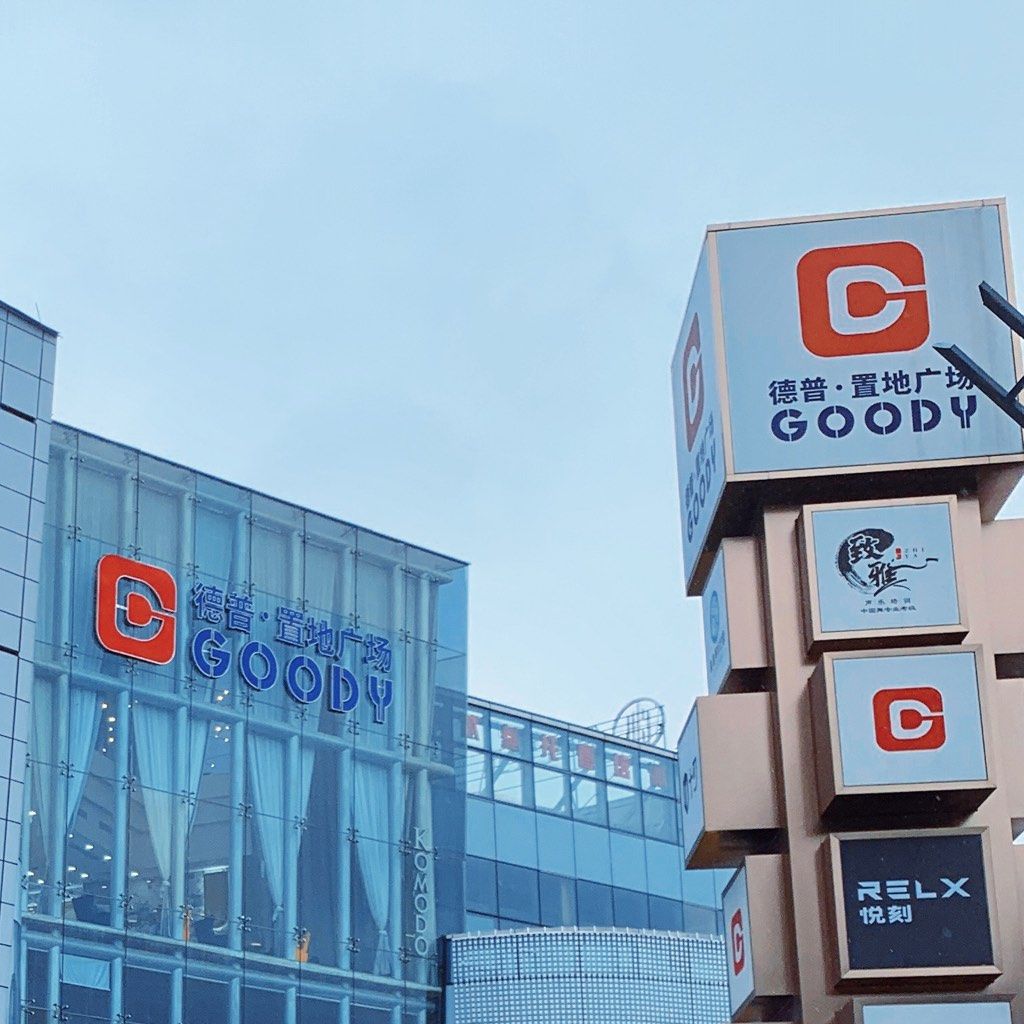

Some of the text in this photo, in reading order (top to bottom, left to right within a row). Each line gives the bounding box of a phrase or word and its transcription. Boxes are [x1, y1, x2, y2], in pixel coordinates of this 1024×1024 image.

[771, 395, 977, 442] GOODY
[191, 581, 392, 673] 德普·置地广场
[192, 628, 394, 723] GOODY
[414, 826, 429, 956] KOMODO
[857, 877, 971, 901] RELX
[859, 904, 913, 925] 悦刻
